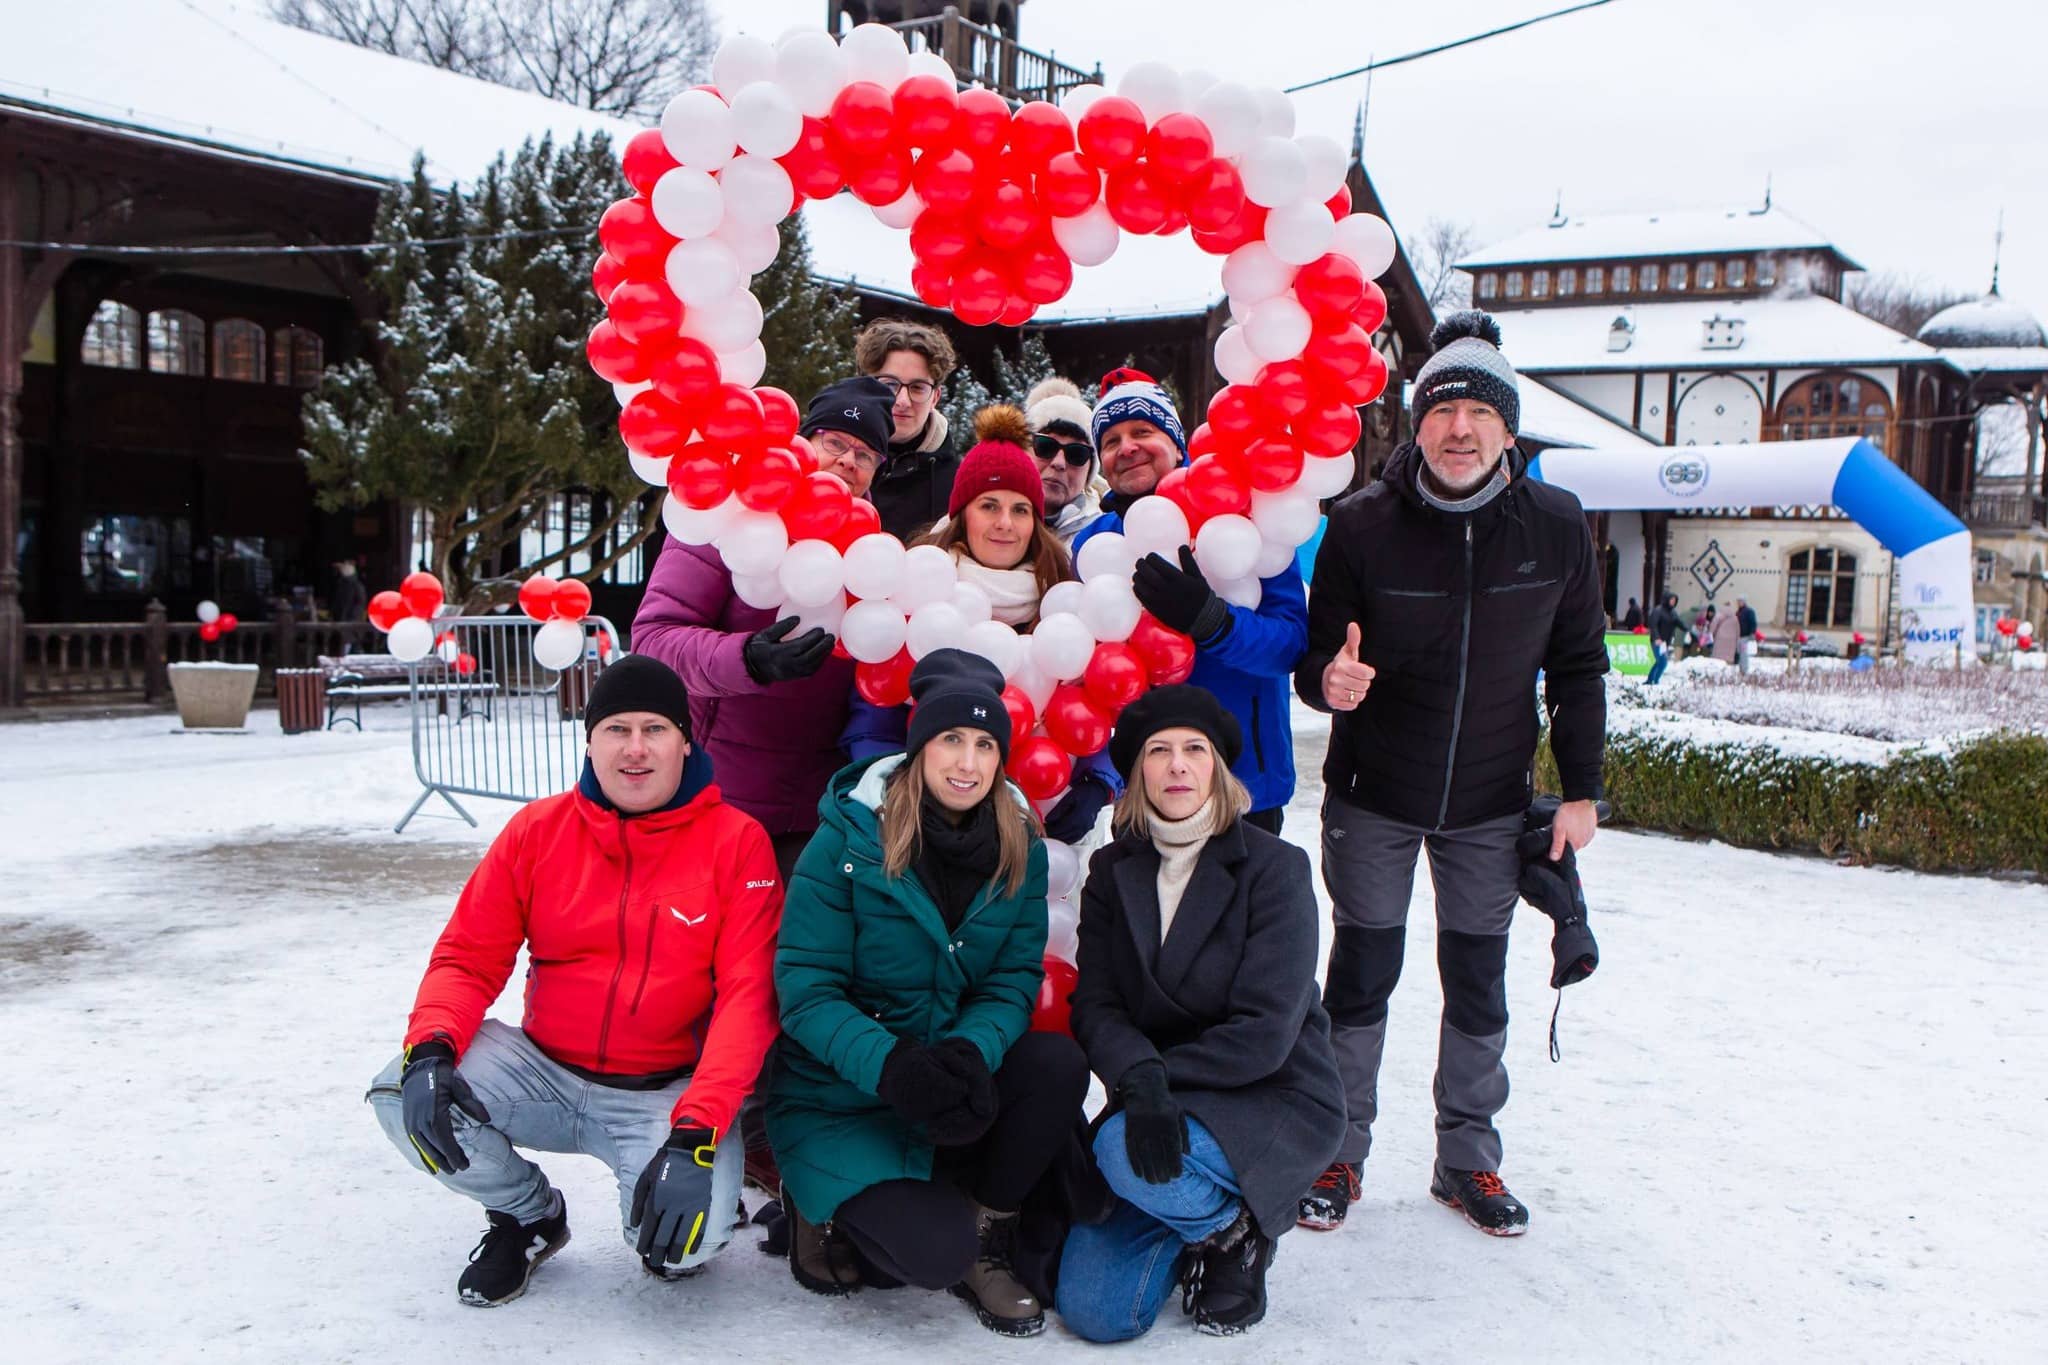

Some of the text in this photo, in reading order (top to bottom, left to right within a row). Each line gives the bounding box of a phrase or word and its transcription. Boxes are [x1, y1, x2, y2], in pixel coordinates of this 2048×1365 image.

[1426, 381, 1468, 397] VIKING
[843, 407, 862, 421] ck
[1517, 561, 1537, 574] 4F
[746, 879, 776, 889] SALEW
